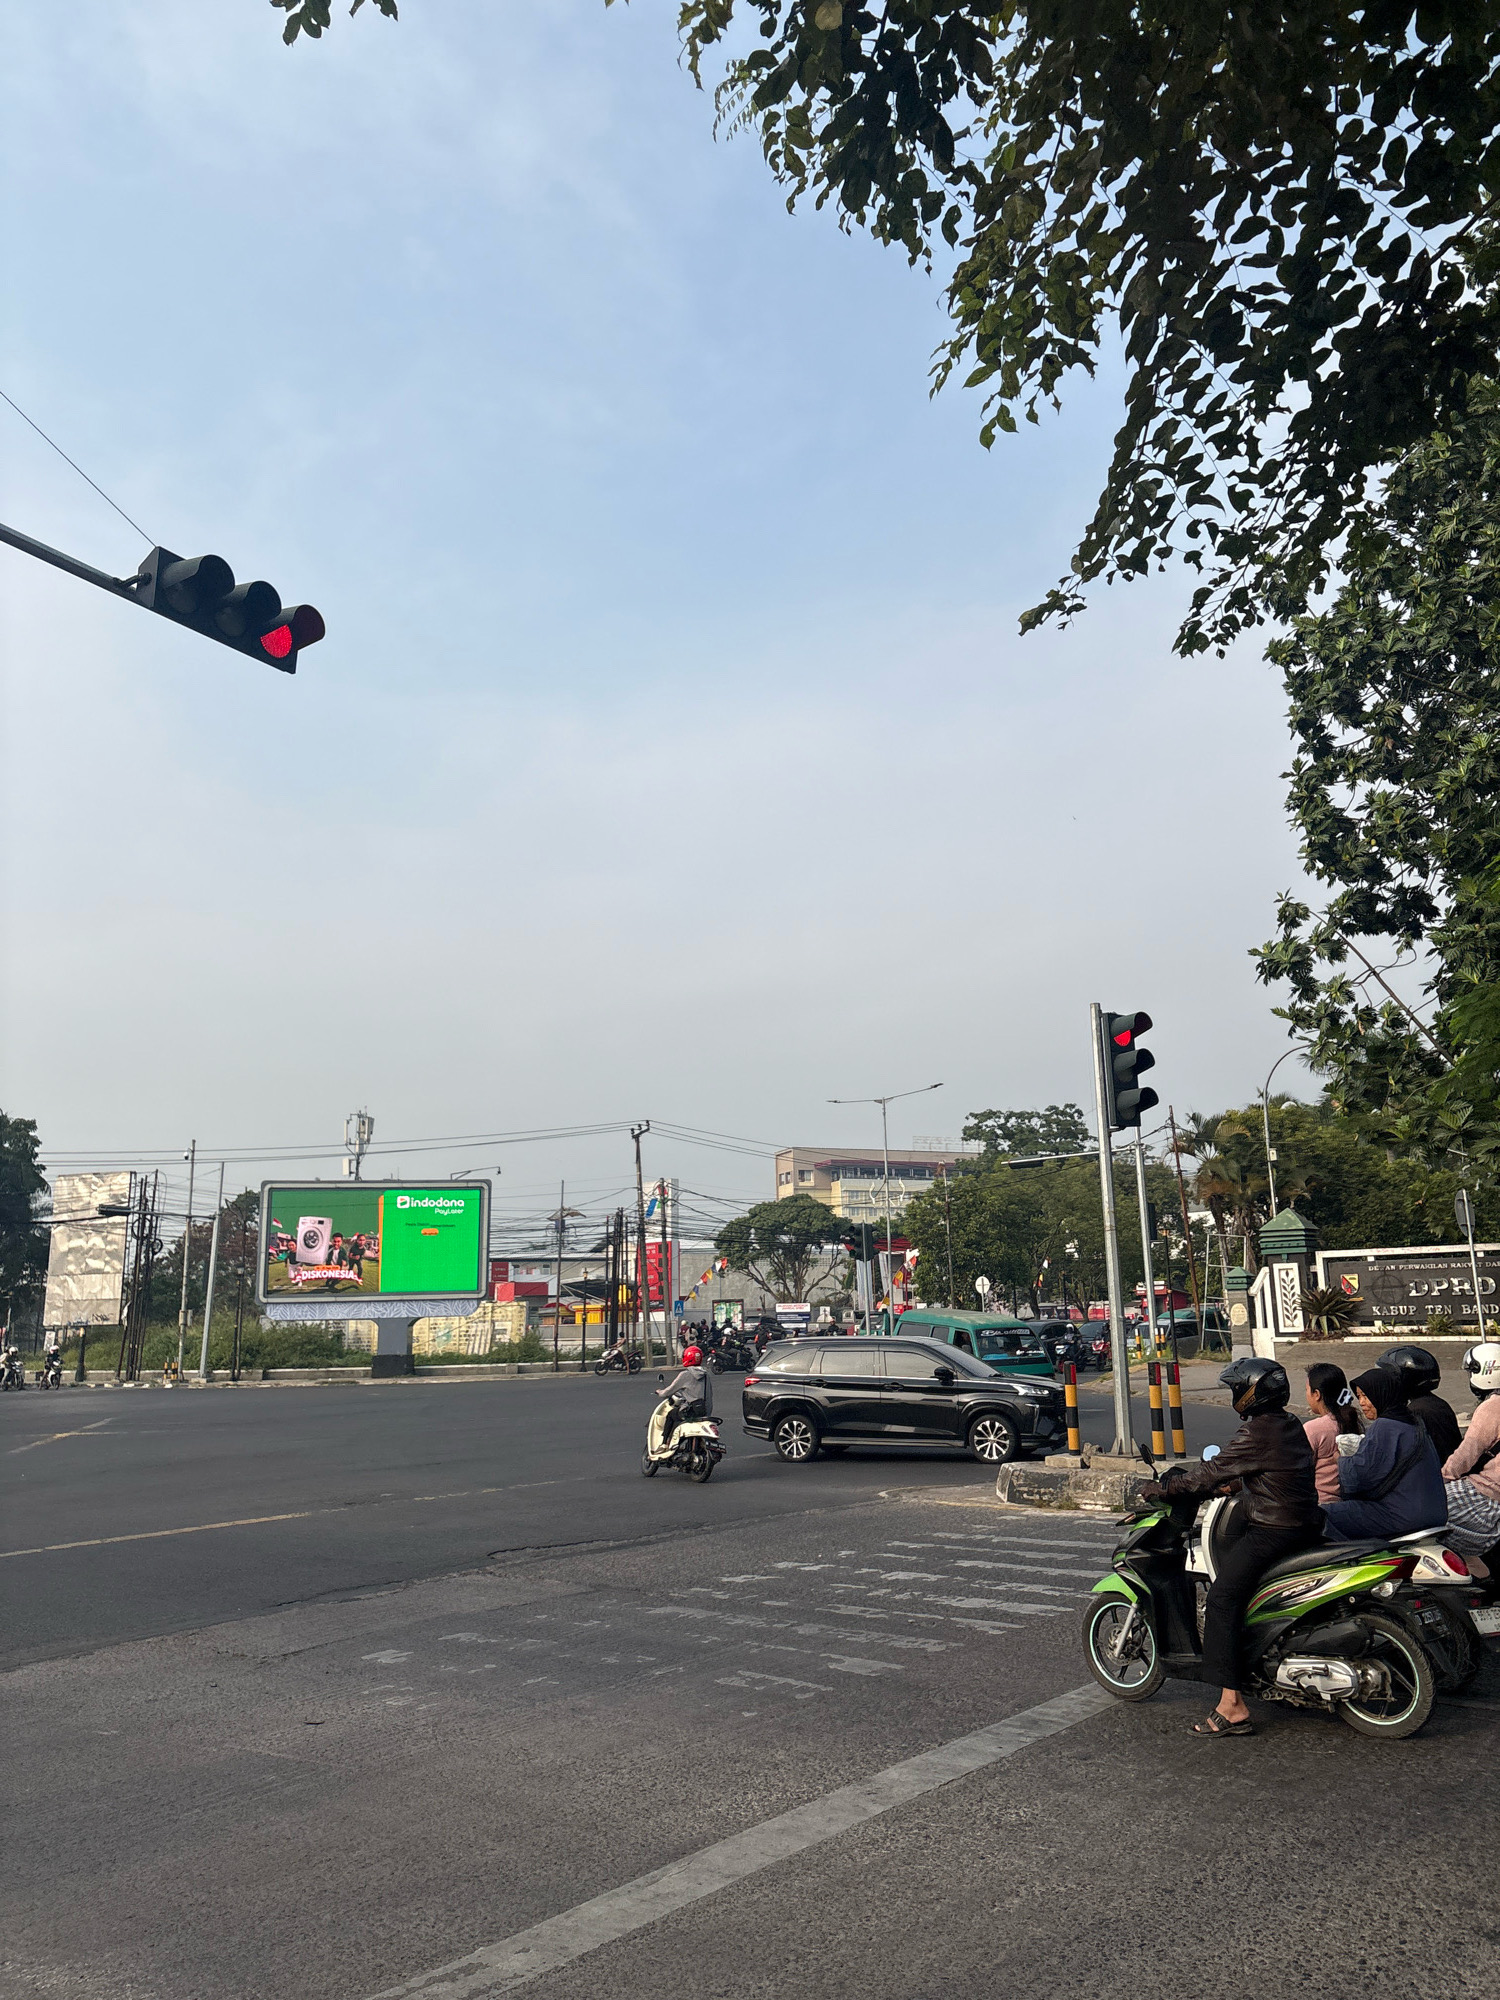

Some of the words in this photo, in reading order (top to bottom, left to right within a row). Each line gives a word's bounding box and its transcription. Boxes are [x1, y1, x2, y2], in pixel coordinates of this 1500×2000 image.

[411, 1197, 465, 1208] indodana
[1368, 1264, 1397, 1272] DEAN
[1399, 1263, 1449, 1271] PERWAKILAN
[302, 1269, 355, 1280] DISKONESIA
[1408, 1277, 1497, 1297] DPRD
